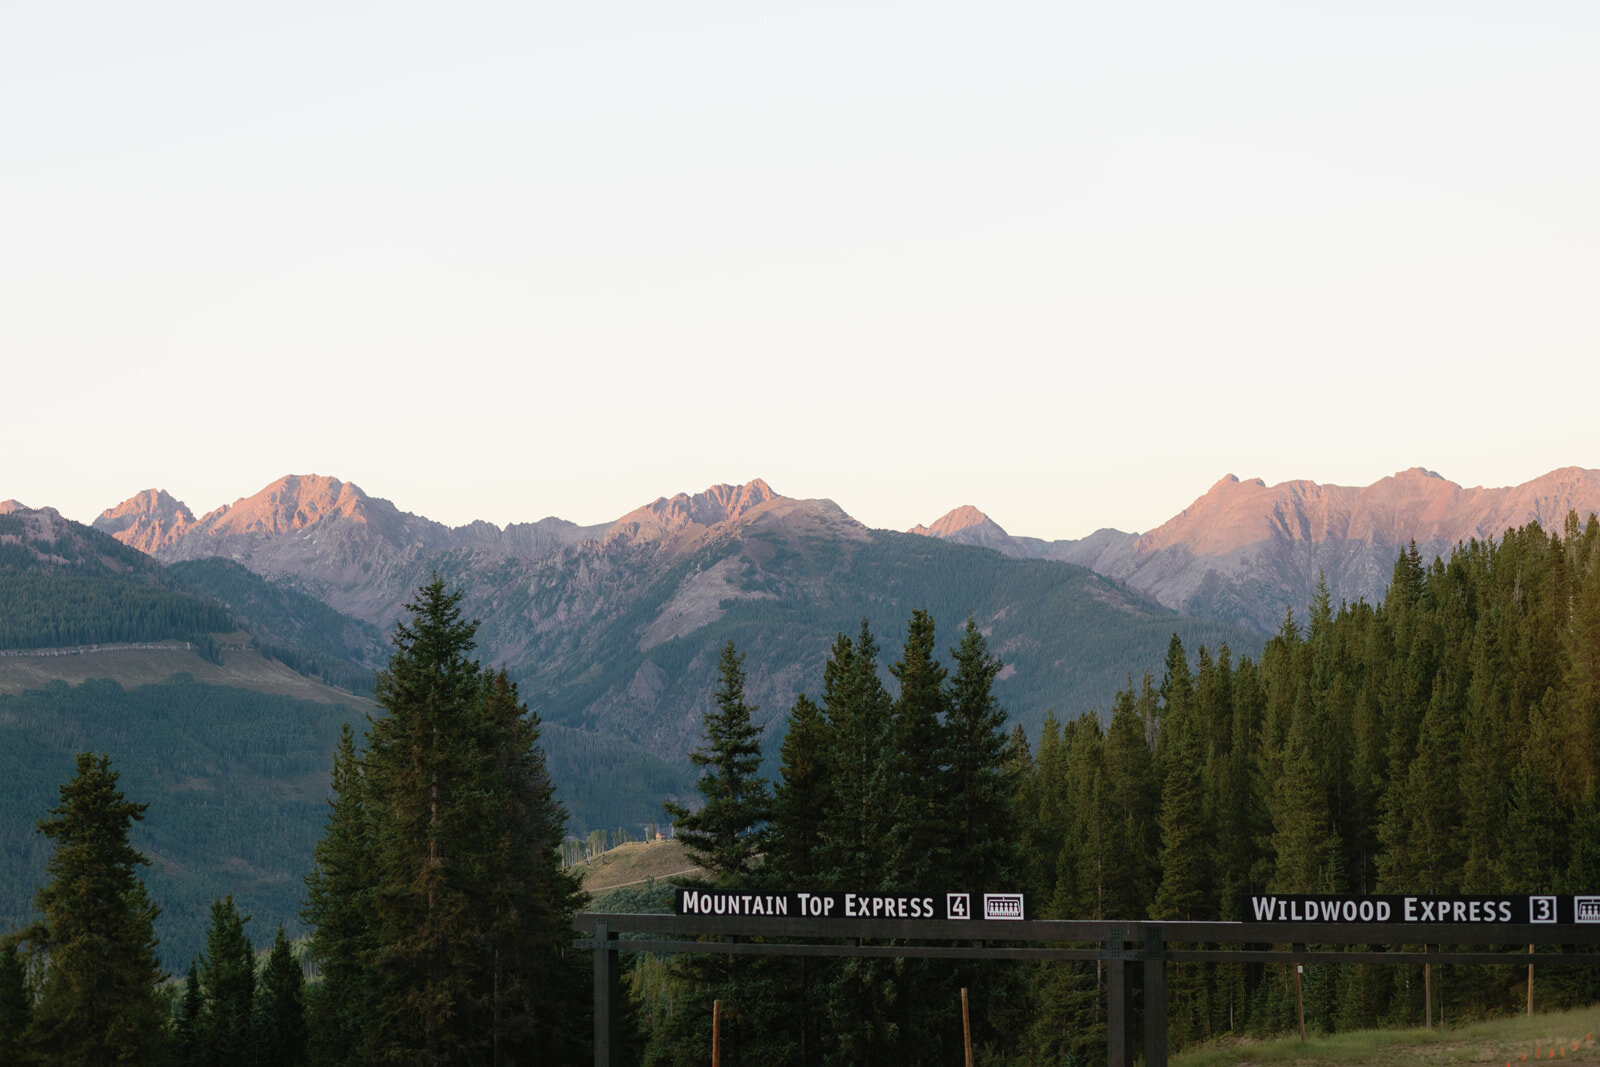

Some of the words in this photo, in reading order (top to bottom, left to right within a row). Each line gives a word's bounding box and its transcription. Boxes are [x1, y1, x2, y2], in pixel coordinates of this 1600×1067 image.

[682, 890, 788, 916] MOUNTAIN
[797, 893, 836, 917] TOP
[845, 893, 935, 919] EXPRESS
[1252, 896, 1392, 922] WILDWOOD
[1404, 897, 1512, 923] EXPRESS
